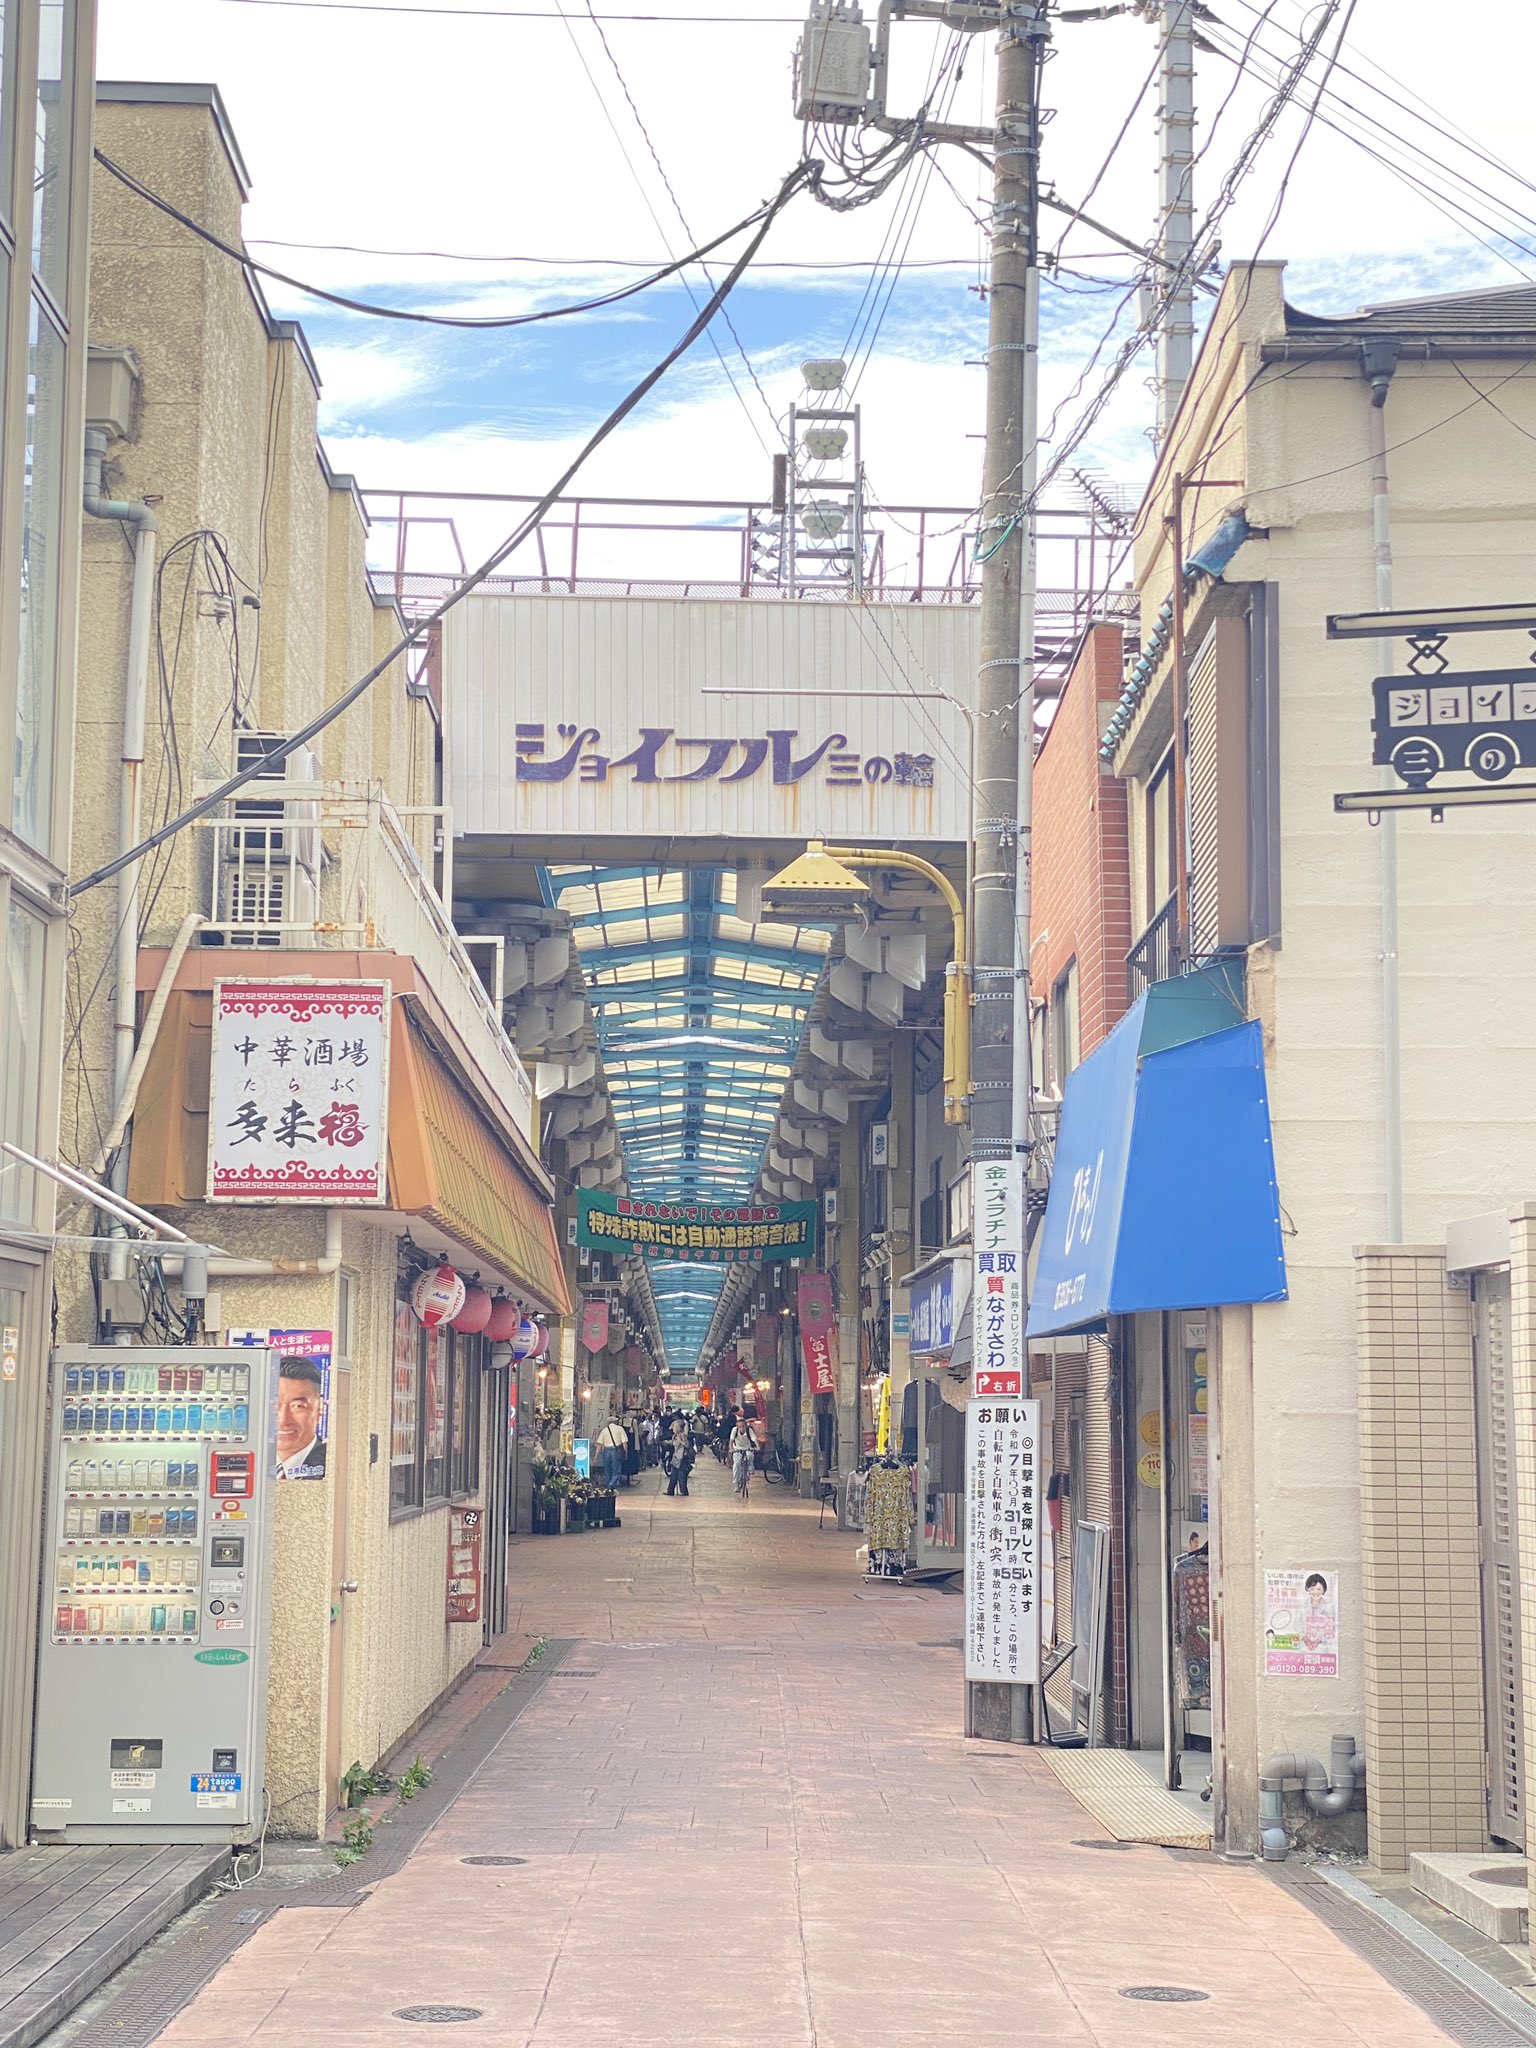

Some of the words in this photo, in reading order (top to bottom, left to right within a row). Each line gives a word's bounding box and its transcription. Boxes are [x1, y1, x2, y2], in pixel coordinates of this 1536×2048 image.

[233, 1035, 370, 1068] 中華酒場
[226, 1099, 368, 1148] 多来福
[984, 1165, 1008, 1249] 金・プラチナ
[978, 1253, 1016, 1274] 買取
[272, 1335, 313, 1346] 人と生活に
[993, 1380, 1017, 1392] 右折
[978, 1408, 1027, 1424] お願い
[210, 1777, 236, 1787] taspo
